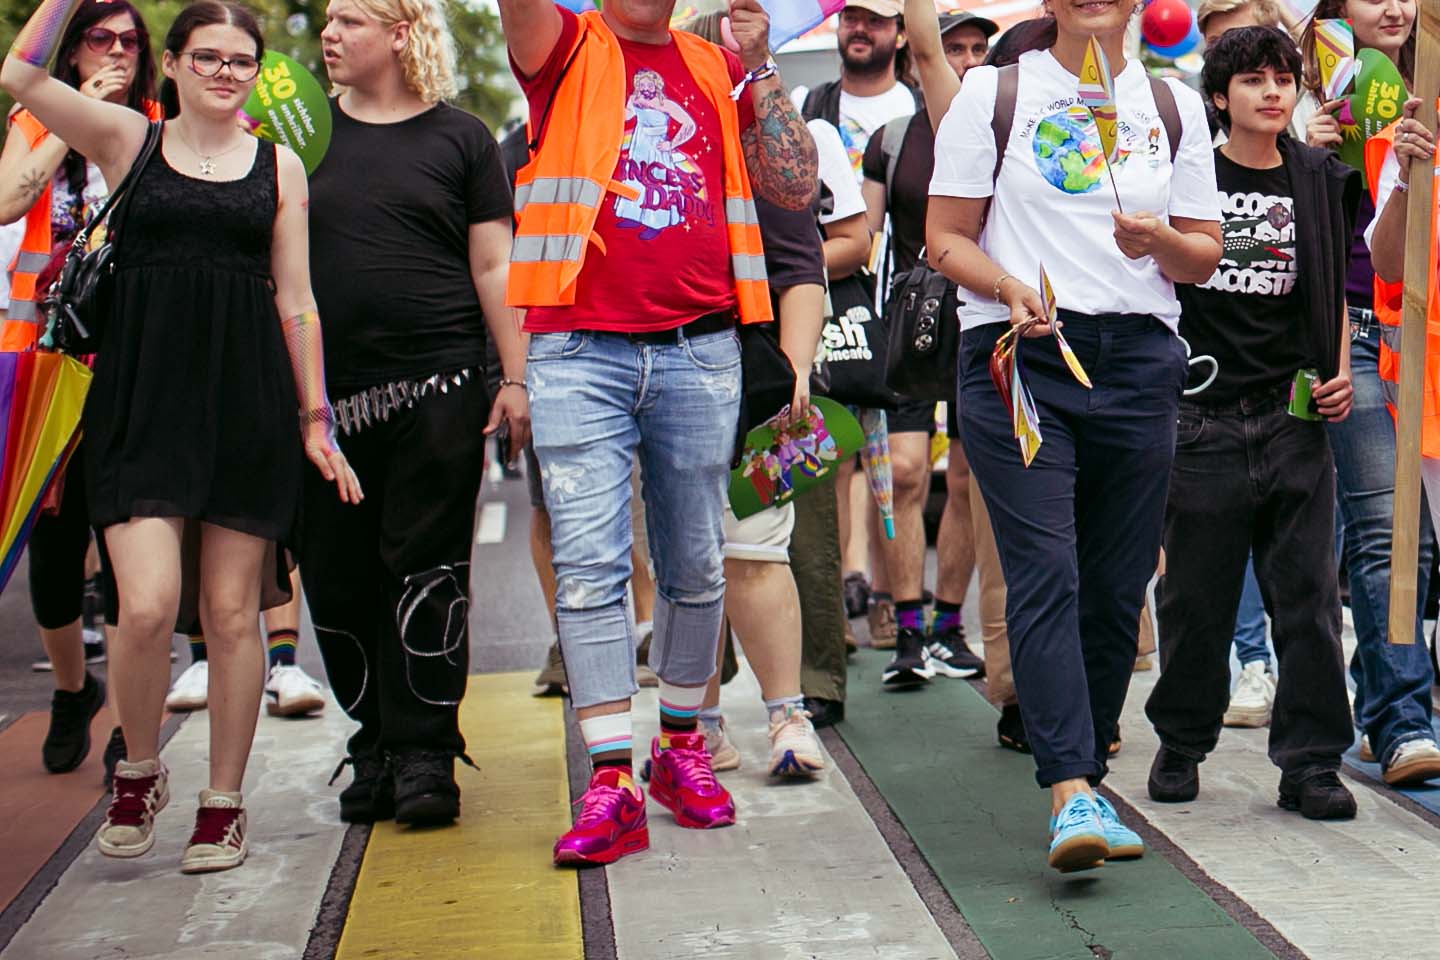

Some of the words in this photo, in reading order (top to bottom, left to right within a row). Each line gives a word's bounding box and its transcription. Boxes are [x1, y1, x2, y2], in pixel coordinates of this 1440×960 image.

[256, 73, 272, 107] ahre
[263, 62, 297, 100] 30
[1365, 79, 1380, 115] Jahre
[1046, 97, 1075, 112] WORLD
[1377, 81, 1401, 119] 30
[614, 158, 704, 193] INCESS
[640, 182, 714, 226] DADDY
